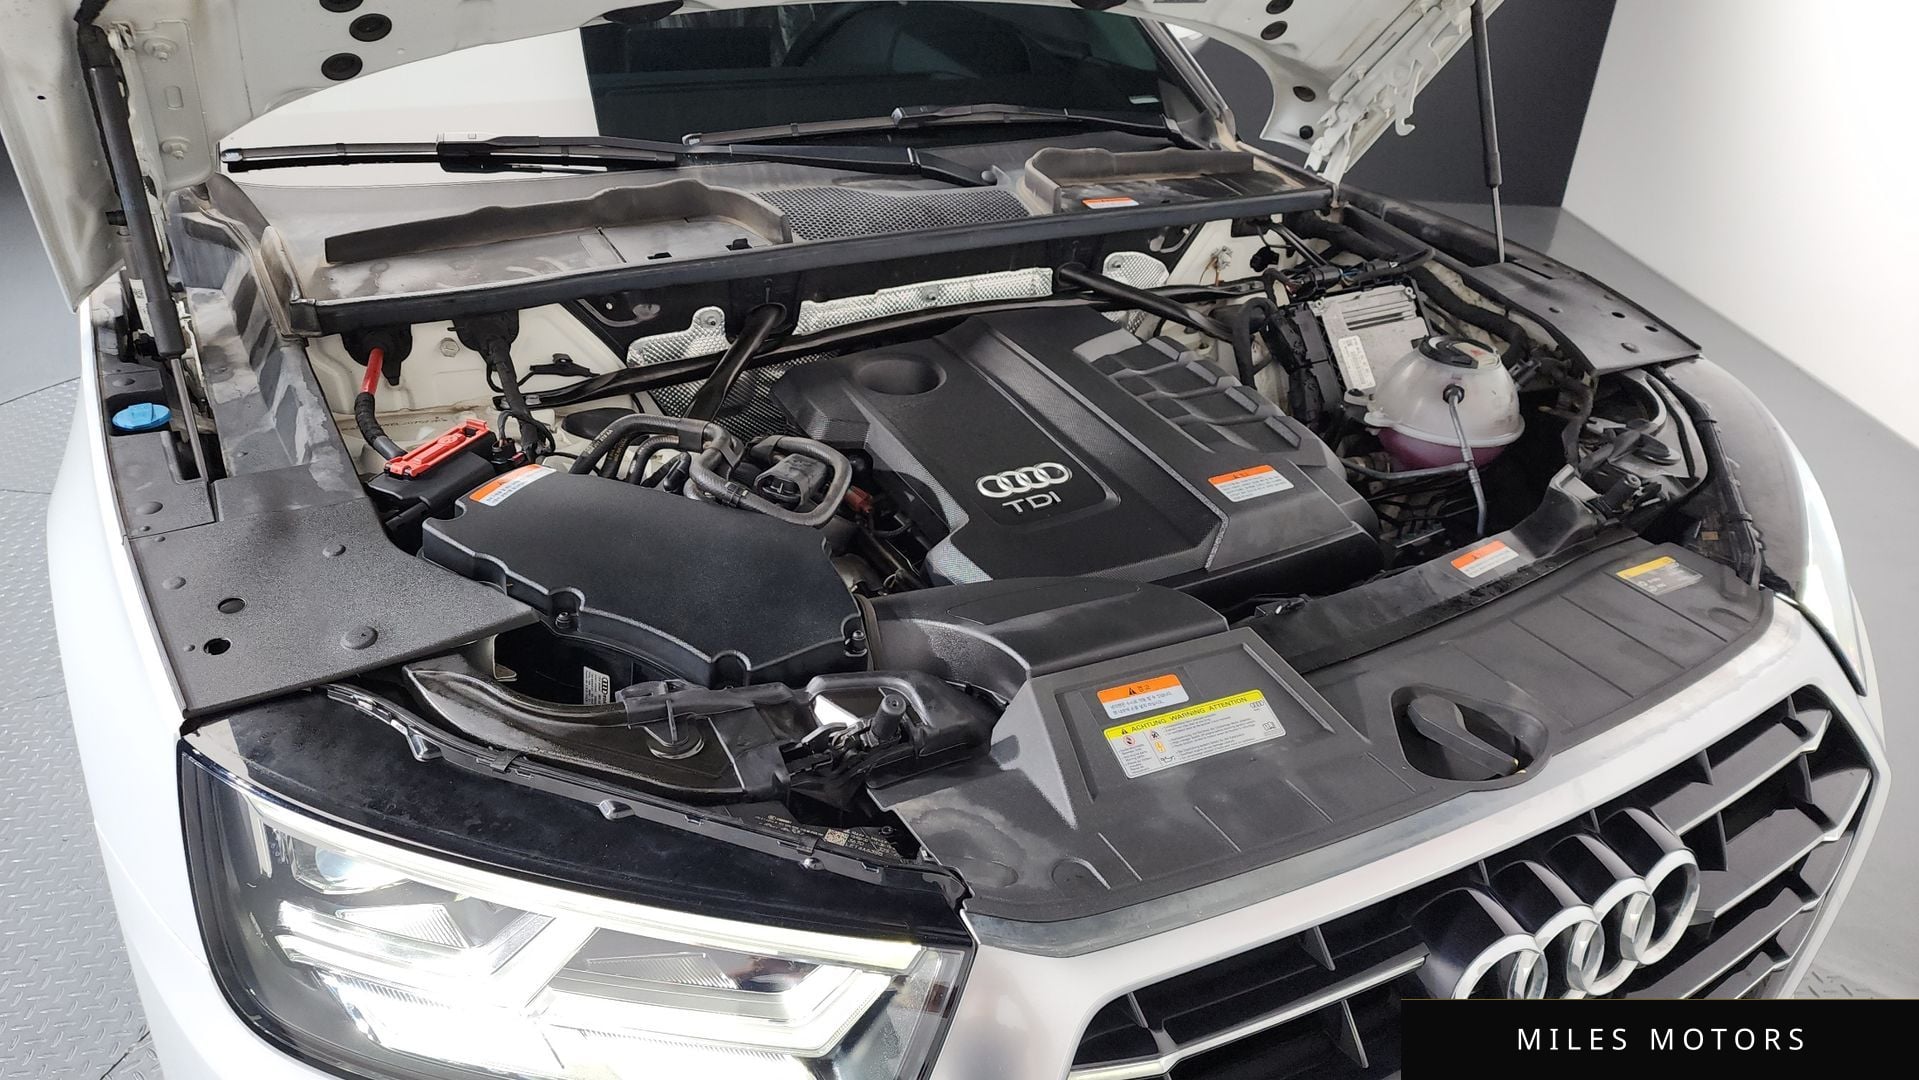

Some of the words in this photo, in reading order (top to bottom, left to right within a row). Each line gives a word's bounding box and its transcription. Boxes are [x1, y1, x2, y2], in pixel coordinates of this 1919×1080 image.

[1002, 491, 1061, 512] TDI
[1131, 719, 1167, 733] ACHTUNG
[1169, 708, 1206, 721] WARNING
[1208, 697, 1248, 711] ATTENTION
